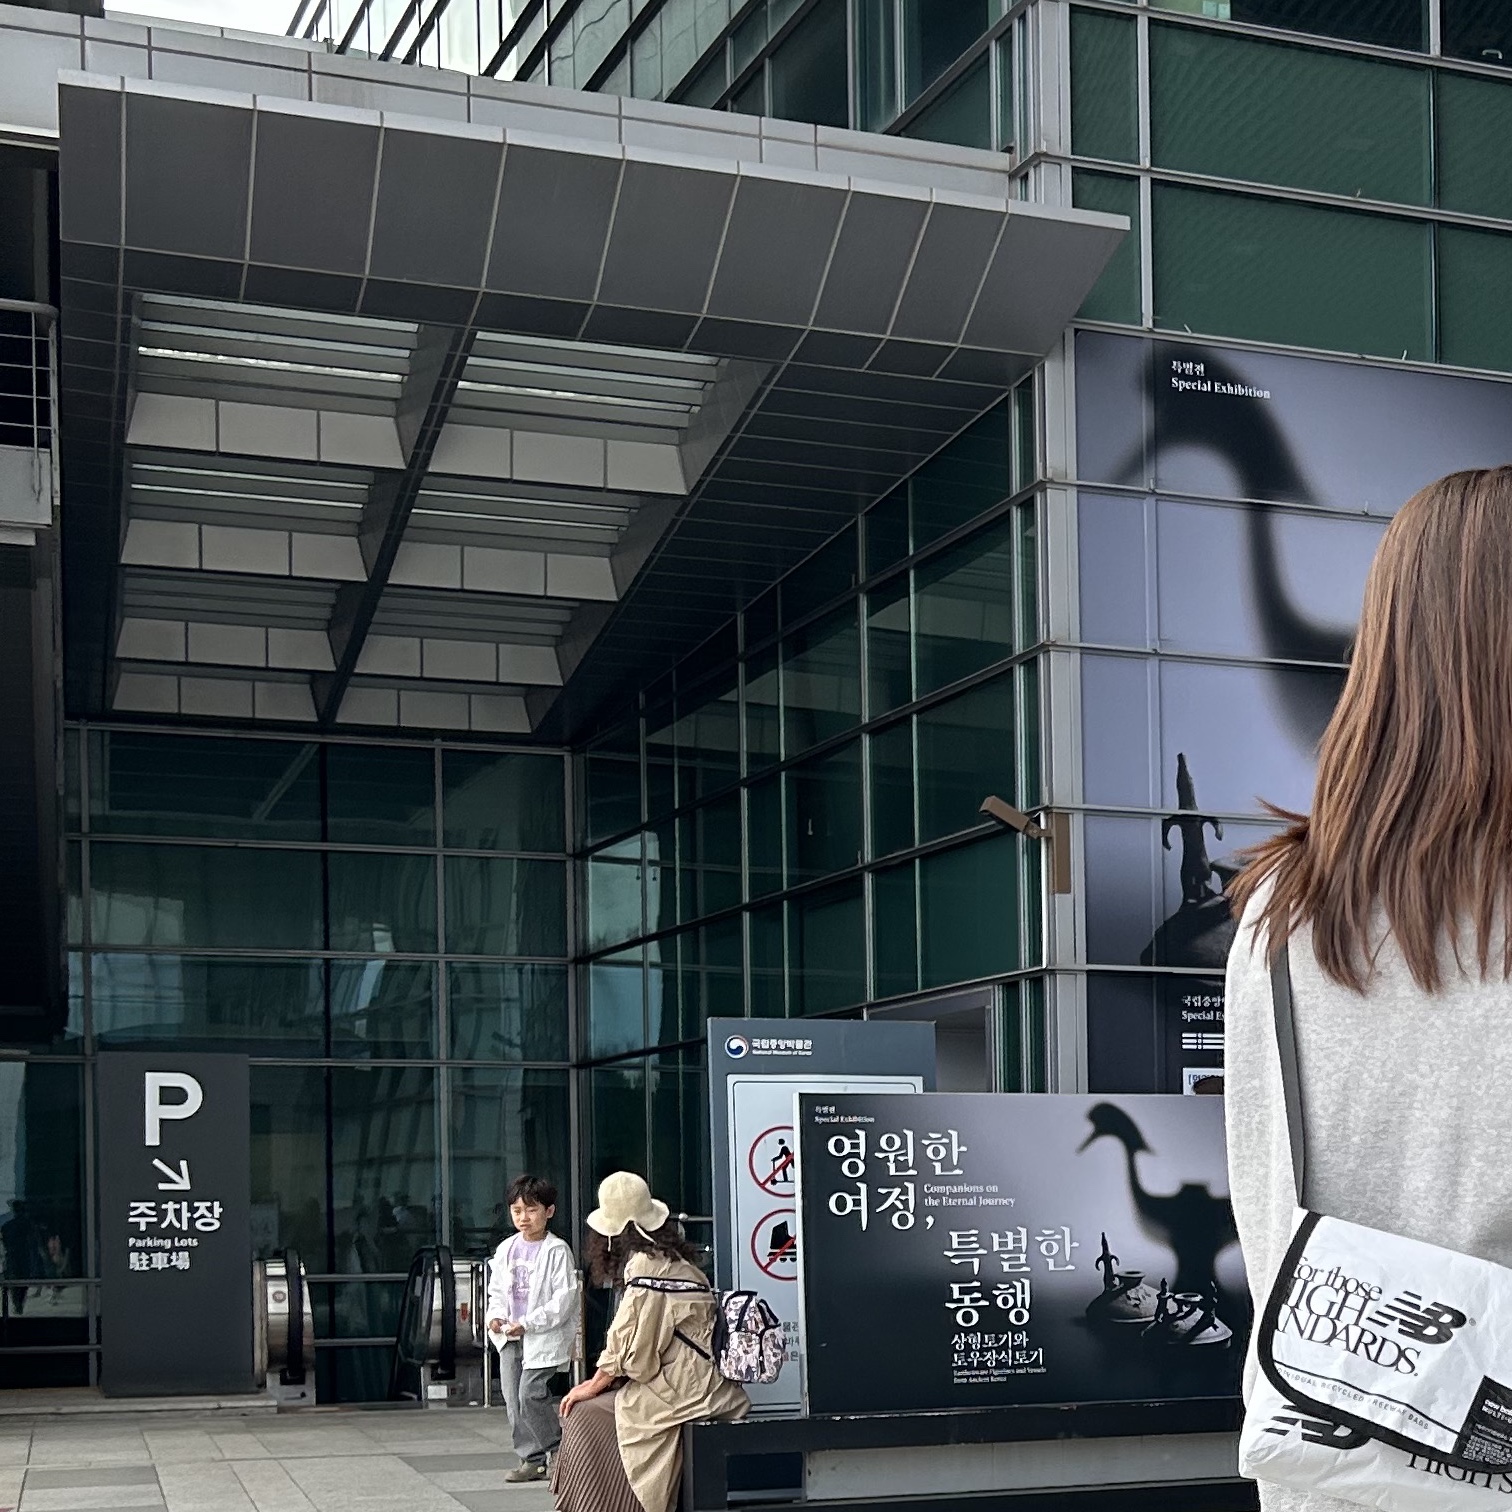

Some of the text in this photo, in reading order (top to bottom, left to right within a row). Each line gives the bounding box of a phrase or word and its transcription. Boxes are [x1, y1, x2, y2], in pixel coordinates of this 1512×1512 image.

[1171, 377, 1271, 399] Special Exhibition
[1181, 1010, 1213, 1022] Special
[145, 1071, 203, 1147] P
[827, 1128, 967, 1178] 영원한
[924, 1183, 999, 1196] Companions on
[828, 1181, 935, 1230] 여정,
[924, 1196, 1016, 1208] the Eternal Journey
[128, 1201, 224, 1231] 주차장
[128, 1236, 199, 1249] Parking Lots
[943, 1225, 1080, 1275] 특별한
[128, 1251, 191, 1271] 駐車場
[1326, 1266, 1383, 1302] those
[944, 1277, 1031, 1327] 동행
[951, 1331, 1029, 1350] 상형토기와
[951, 1347, 1043, 1367] 토우장식토기
